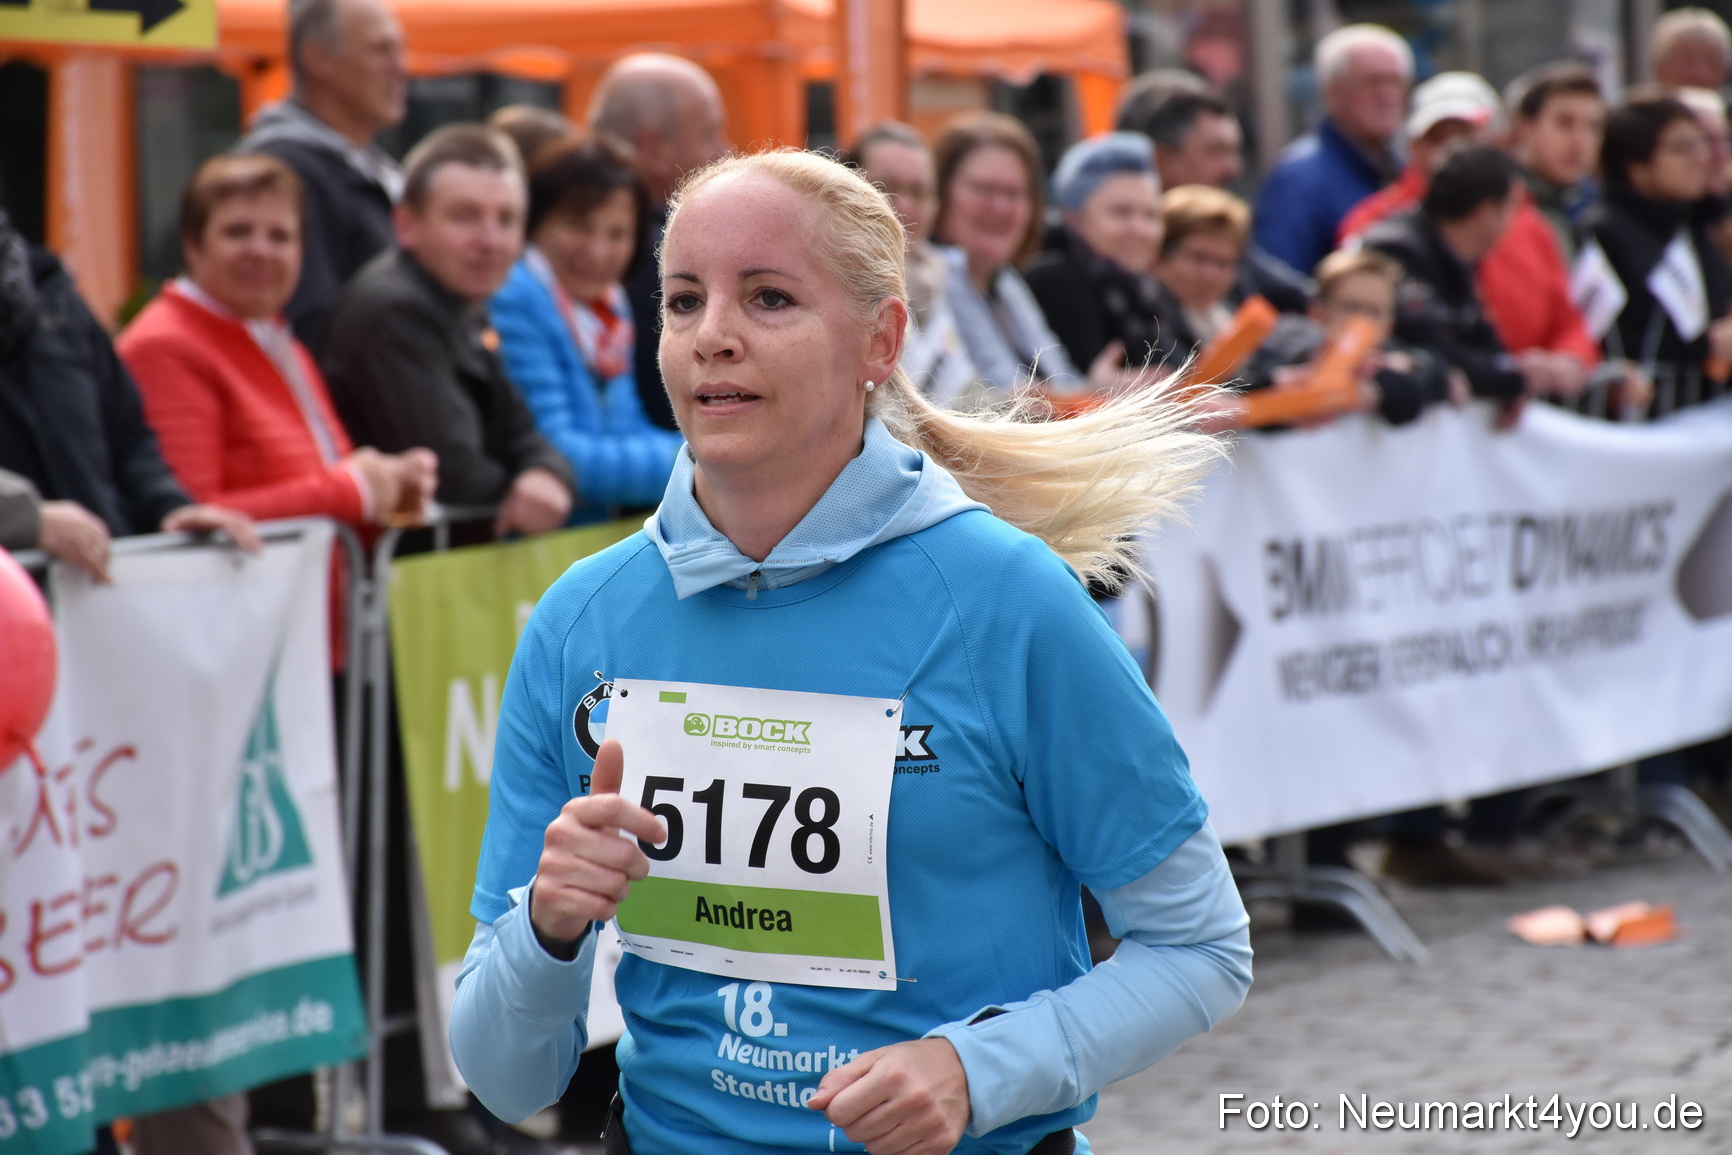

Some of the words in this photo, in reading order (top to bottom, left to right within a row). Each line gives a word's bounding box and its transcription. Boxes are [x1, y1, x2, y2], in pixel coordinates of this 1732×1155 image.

[711, 739, 741, 750] inspired
[742, 741, 752, 751] by
[754, 743, 776, 752] smart
[777, 746, 811, 755] concepts
[712, 715, 812, 745] BOCK
[894, 763, 940, 776] oncepts
[637, 775, 841, 875] 5178
[695, 896, 793, 932] Andrea
[717, 981, 788, 1038] 18.
[717, 1033, 862, 1073] Neumarkt
[711, 1069, 818, 1109] Stadtla
